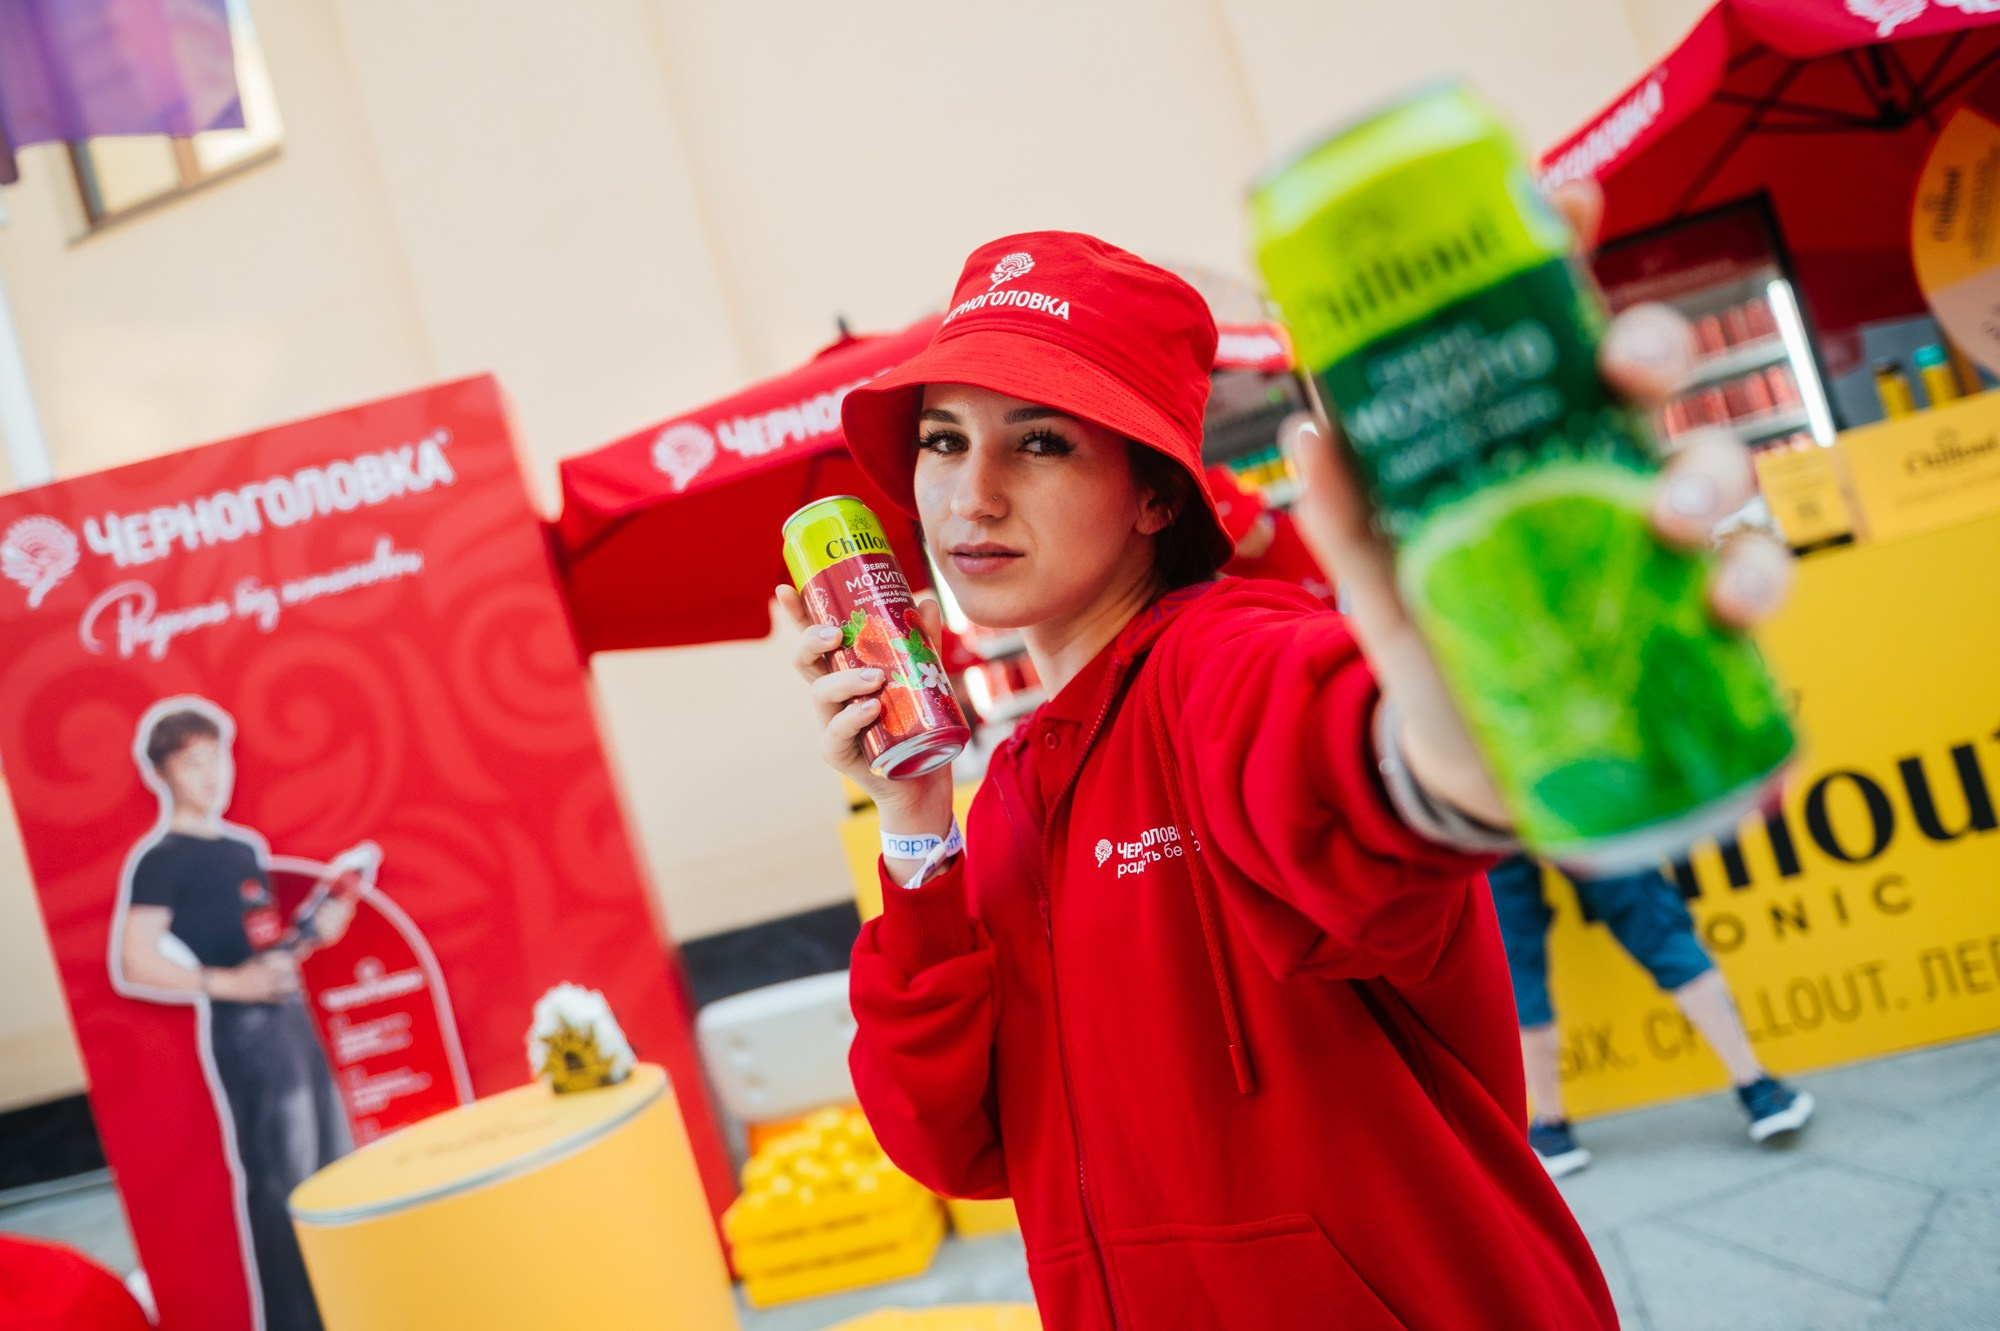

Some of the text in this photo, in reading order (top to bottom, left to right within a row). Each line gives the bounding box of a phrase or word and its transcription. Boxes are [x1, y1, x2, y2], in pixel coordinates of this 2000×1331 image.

[84, 438, 455, 568] ЧЕРНОГОЛОВКА
[863, 562, 889, 571] BERRY
[845, 571, 907, 592] МОХИТО
[1163, 843, 1184, 858] бе
[1704, 874, 1913, 955] ONIC
